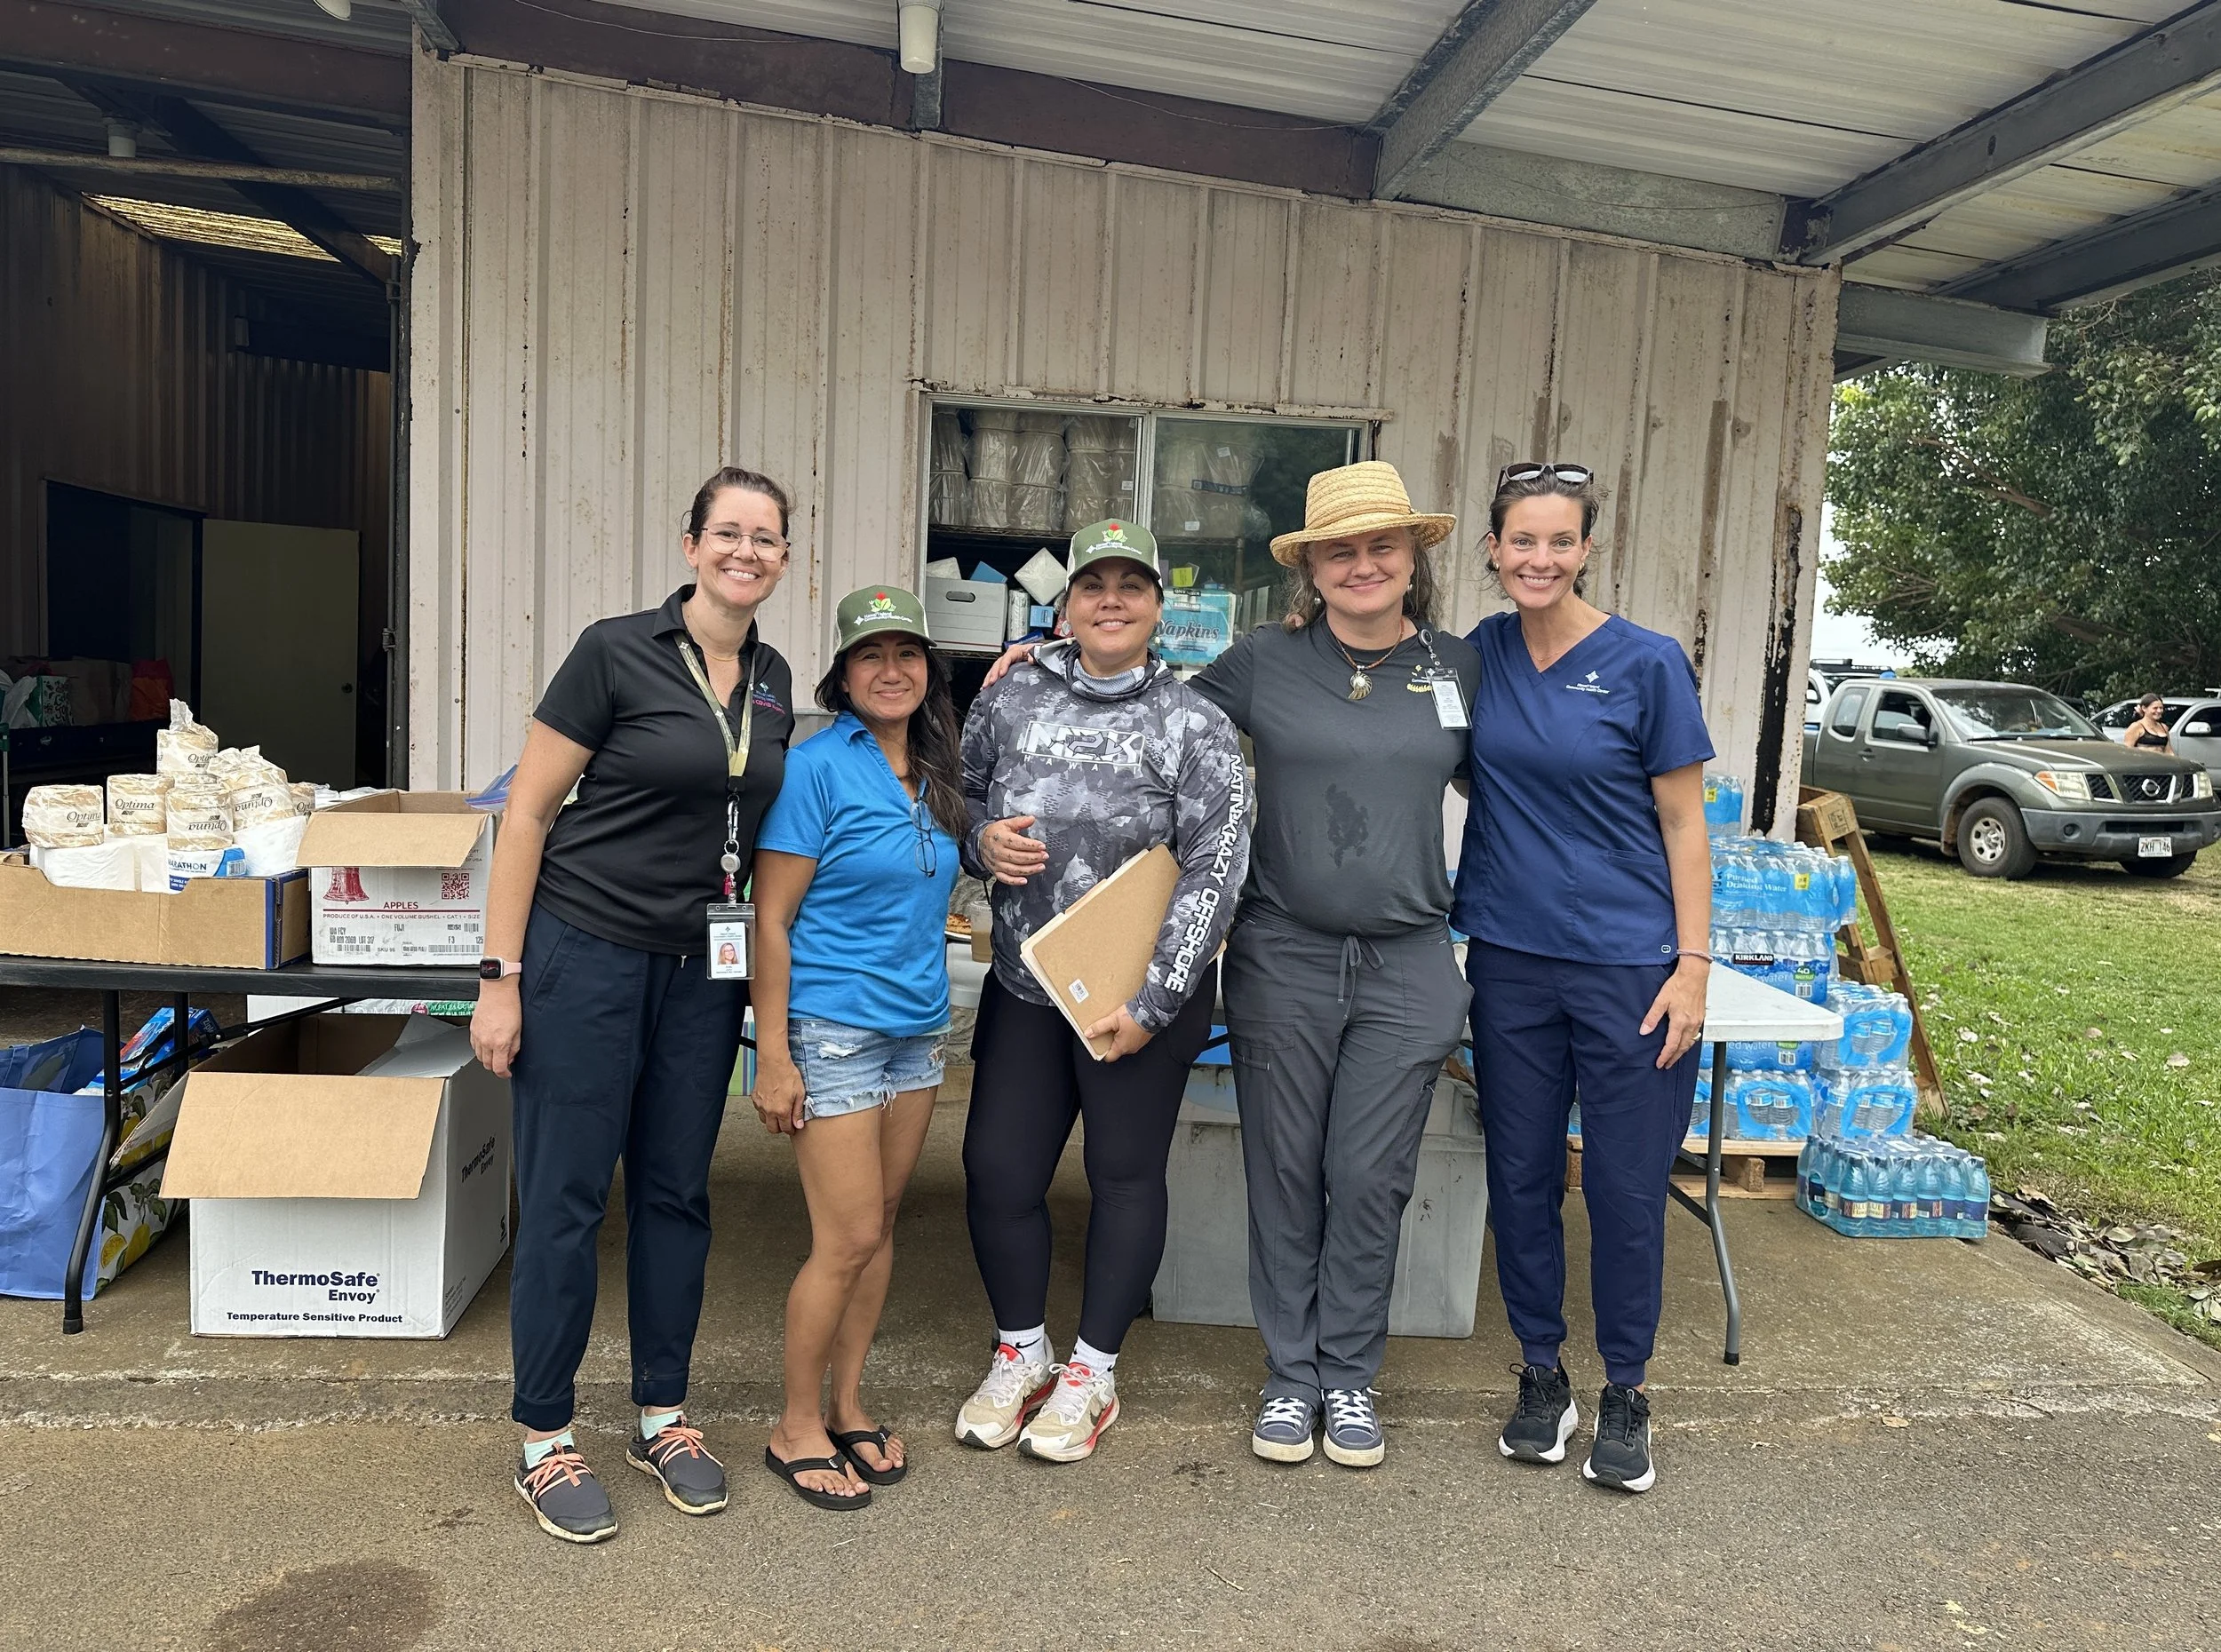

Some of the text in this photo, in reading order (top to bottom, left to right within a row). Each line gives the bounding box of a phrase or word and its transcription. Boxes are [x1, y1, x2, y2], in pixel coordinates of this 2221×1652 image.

[115, 798, 155, 810] Optima
[235, 796, 274, 813] Optima
[67, 811, 102, 822] Optima
[188, 819, 227, 832] Optima
[1764, 883, 1787, 893] Water
[1163, 887, 1221, 993] OFFSHORE
[1761, 973, 1787, 983] water
[1744, 1041, 1772, 1050] water
[461, 1135, 496, 1184] ThermoSafe
[251, 1270, 378, 1287] ThermoSafe
[329, 1289, 376, 1304] Envoy
[227, 1312, 403, 1323] Temperature Sensitive Product
